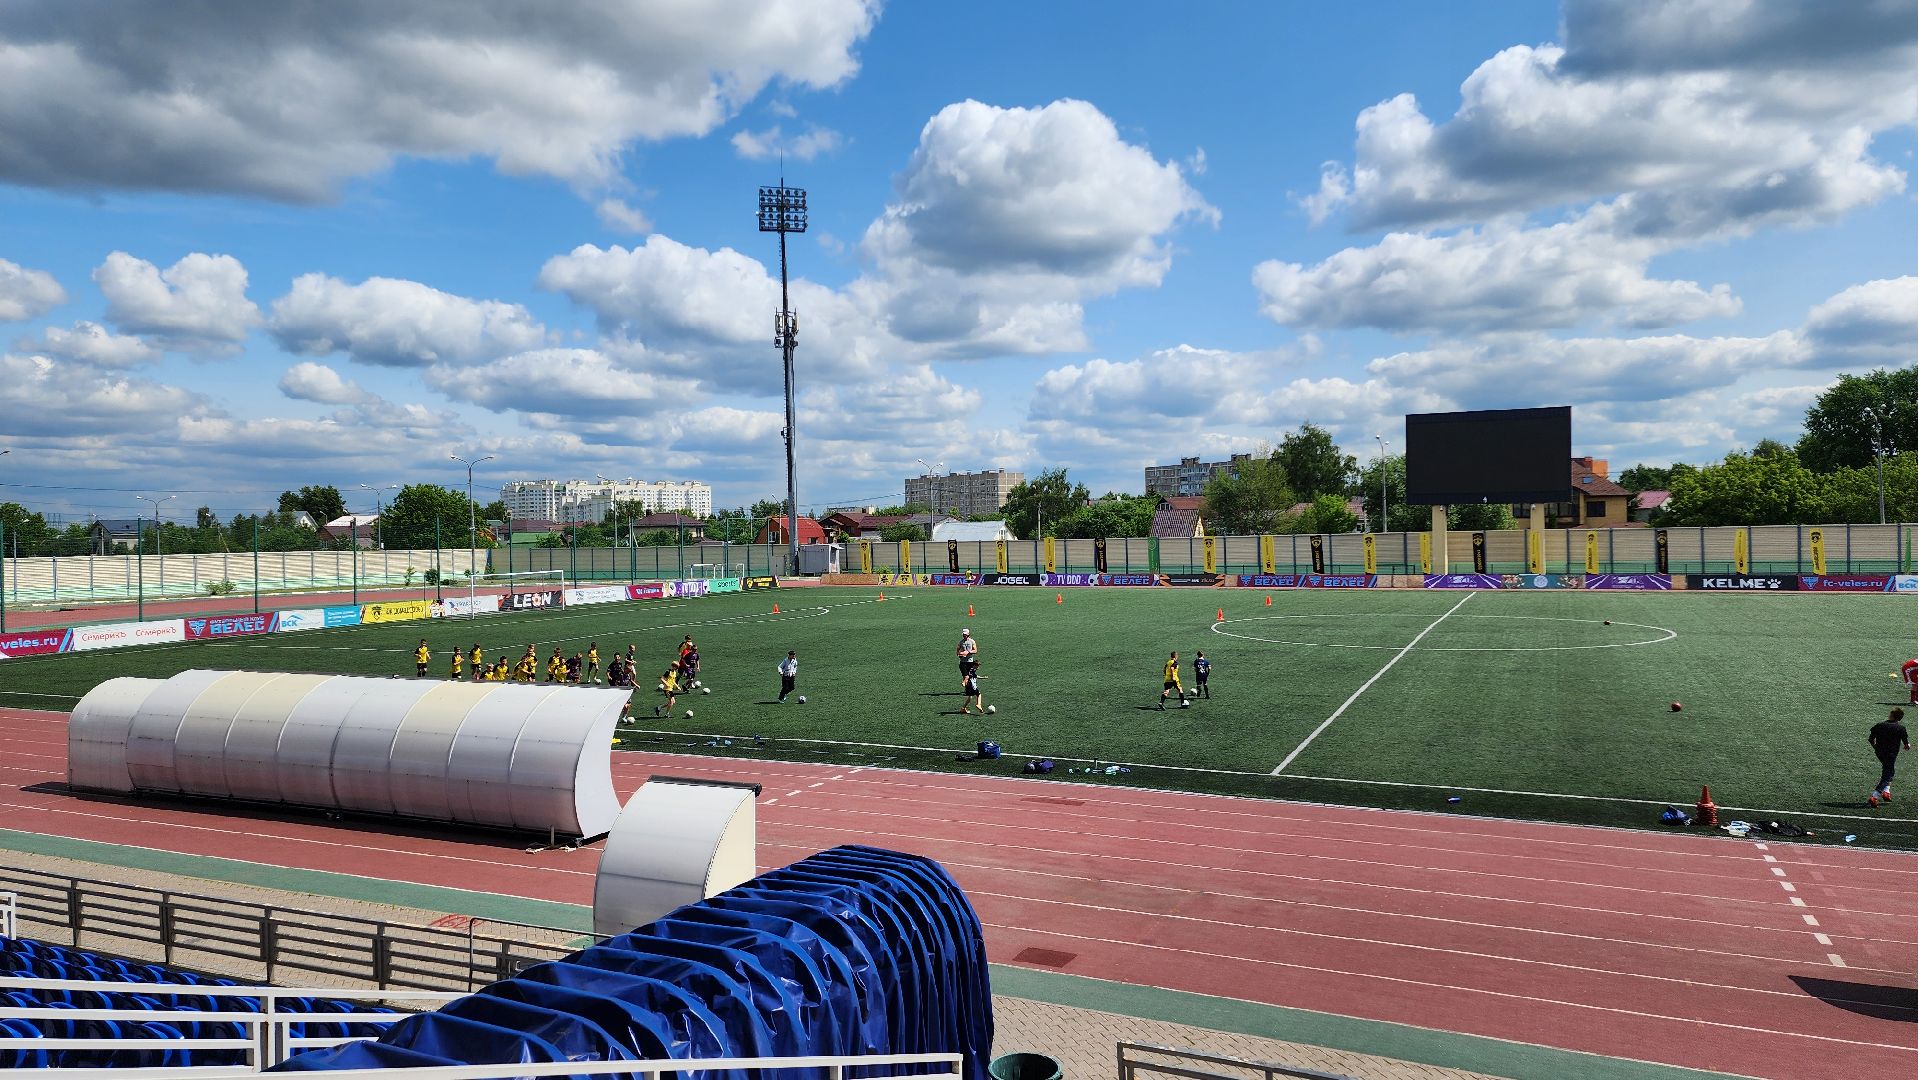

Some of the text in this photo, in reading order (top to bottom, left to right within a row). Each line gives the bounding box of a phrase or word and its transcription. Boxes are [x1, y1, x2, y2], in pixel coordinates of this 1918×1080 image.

[1703, 578, 1766, 588] KELME
[513, 592, 552, 608] LEON
[210, 621, 265, 634] ВЕЛЕС
[281, 619, 298, 628] ВСК
[81, 631, 127, 641] СемерикЪ
[136, 626, 177, 637] СемерикЪ
[0, 637, 58, 650] veles.ru
